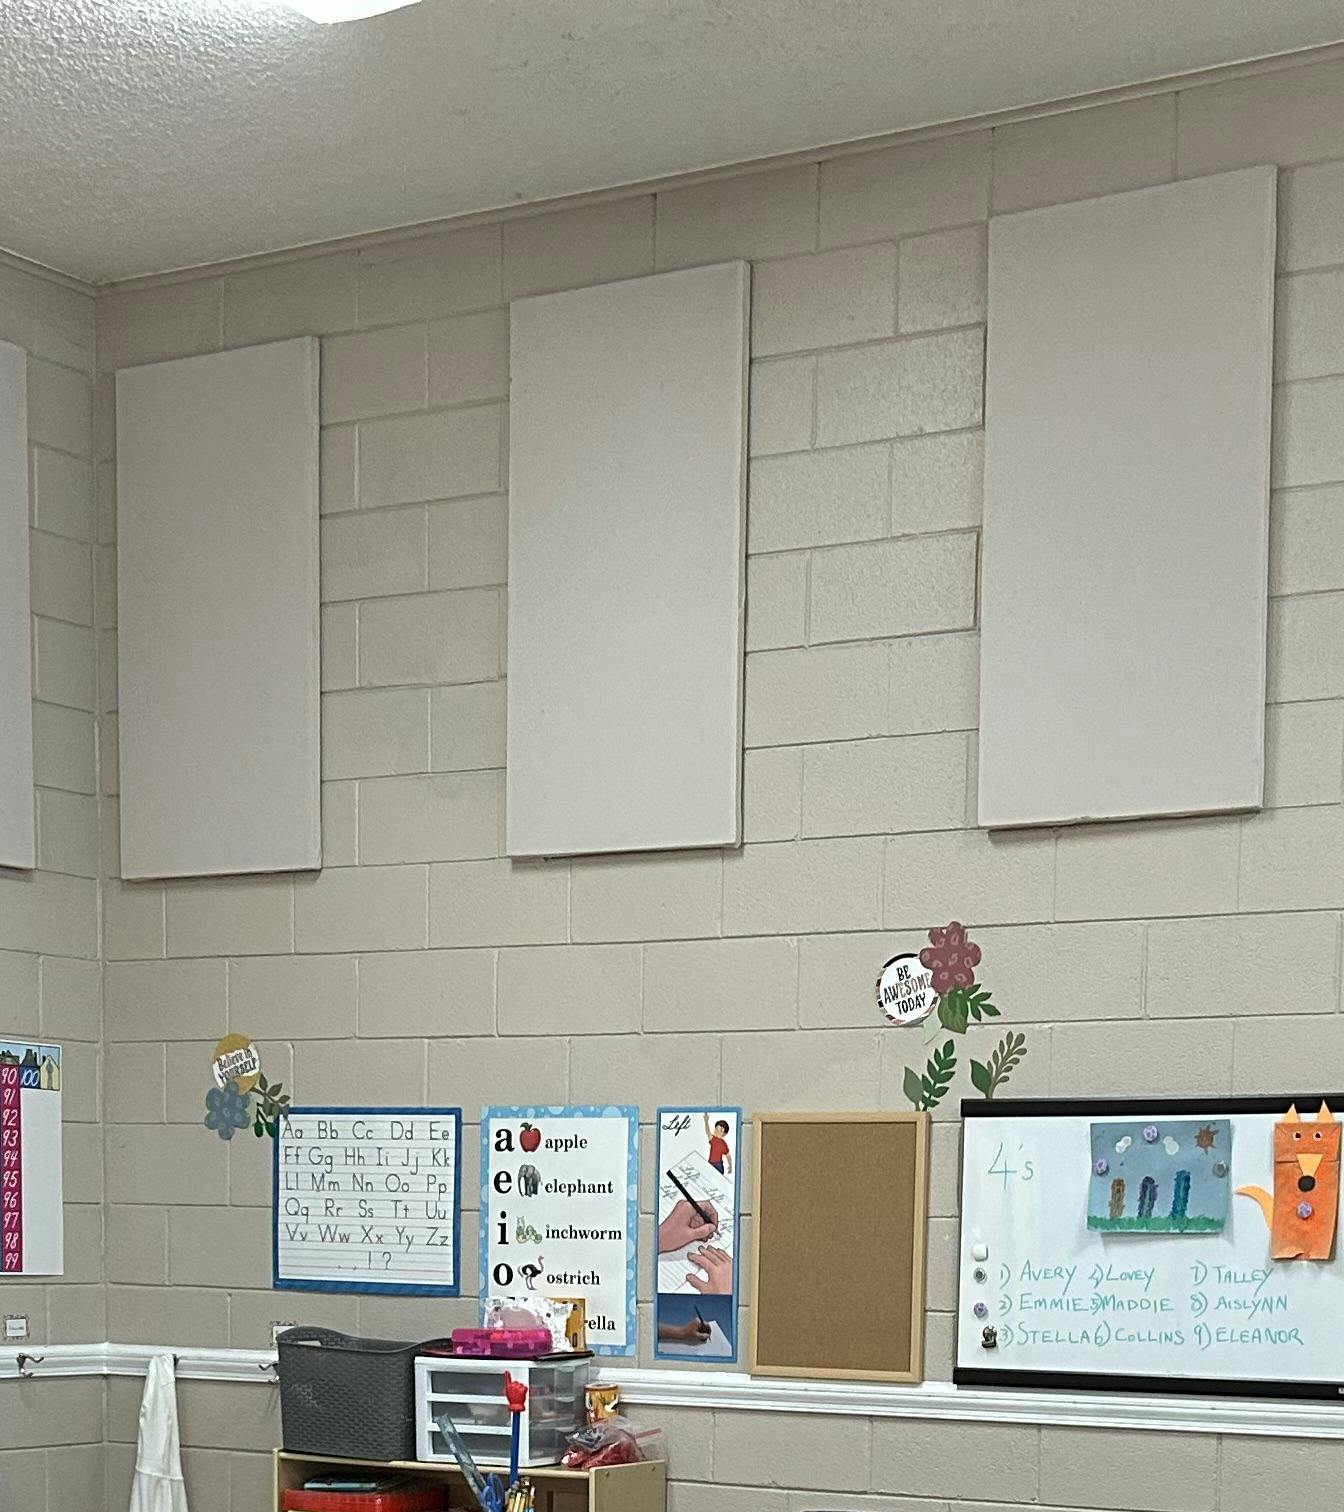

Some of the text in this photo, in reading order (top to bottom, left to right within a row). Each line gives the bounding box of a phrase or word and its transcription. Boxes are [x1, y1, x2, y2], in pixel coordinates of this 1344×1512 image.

[896, 965, 911, 981] BE
[884, 972, 932, 1004] AWESOME
[895, 992, 926, 1015] TODAY
[2, 1067, 18, 1085] 90
[22, 1070, 39, 1086] 100
[282, 1120, 450, 1140] Aa Bb Cc Dd Ee
[662, 1114, 692, 1136] Left
[494, 1128, 588, 1152] a apple
[284, 1146, 450, 1175] Ff Gg Hh Ii Jj Kk
[987, 1142, 1034, 1190] 4's
[285, 1171, 447, 1200] Ll Mm Nn Oo Pp
[494, 1171, 614, 1199] e elephant
[285, 1197, 446, 1224] Qq Rr Ss Tt Uu
[285, 1224, 449, 1253] Vv Ww Xx Yy Zz
[497, 1210, 622, 1245] i inchworm
[493, 1263, 600, 1286] o ostrich
[1020, 1259, 1077, 1296] AVERY
[1212, 1265, 1274, 1296] TALLEY
[1020, 1293, 1089, 1311] EMMIE
[1101, 1294, 1174, 1314] MADDIE
[1017, 1322, 1090, 1345] STELLA
[1115, 1328, 1184, 1345] COLLINS
[1216, 1327, 1304, 1345] ELEANOR
